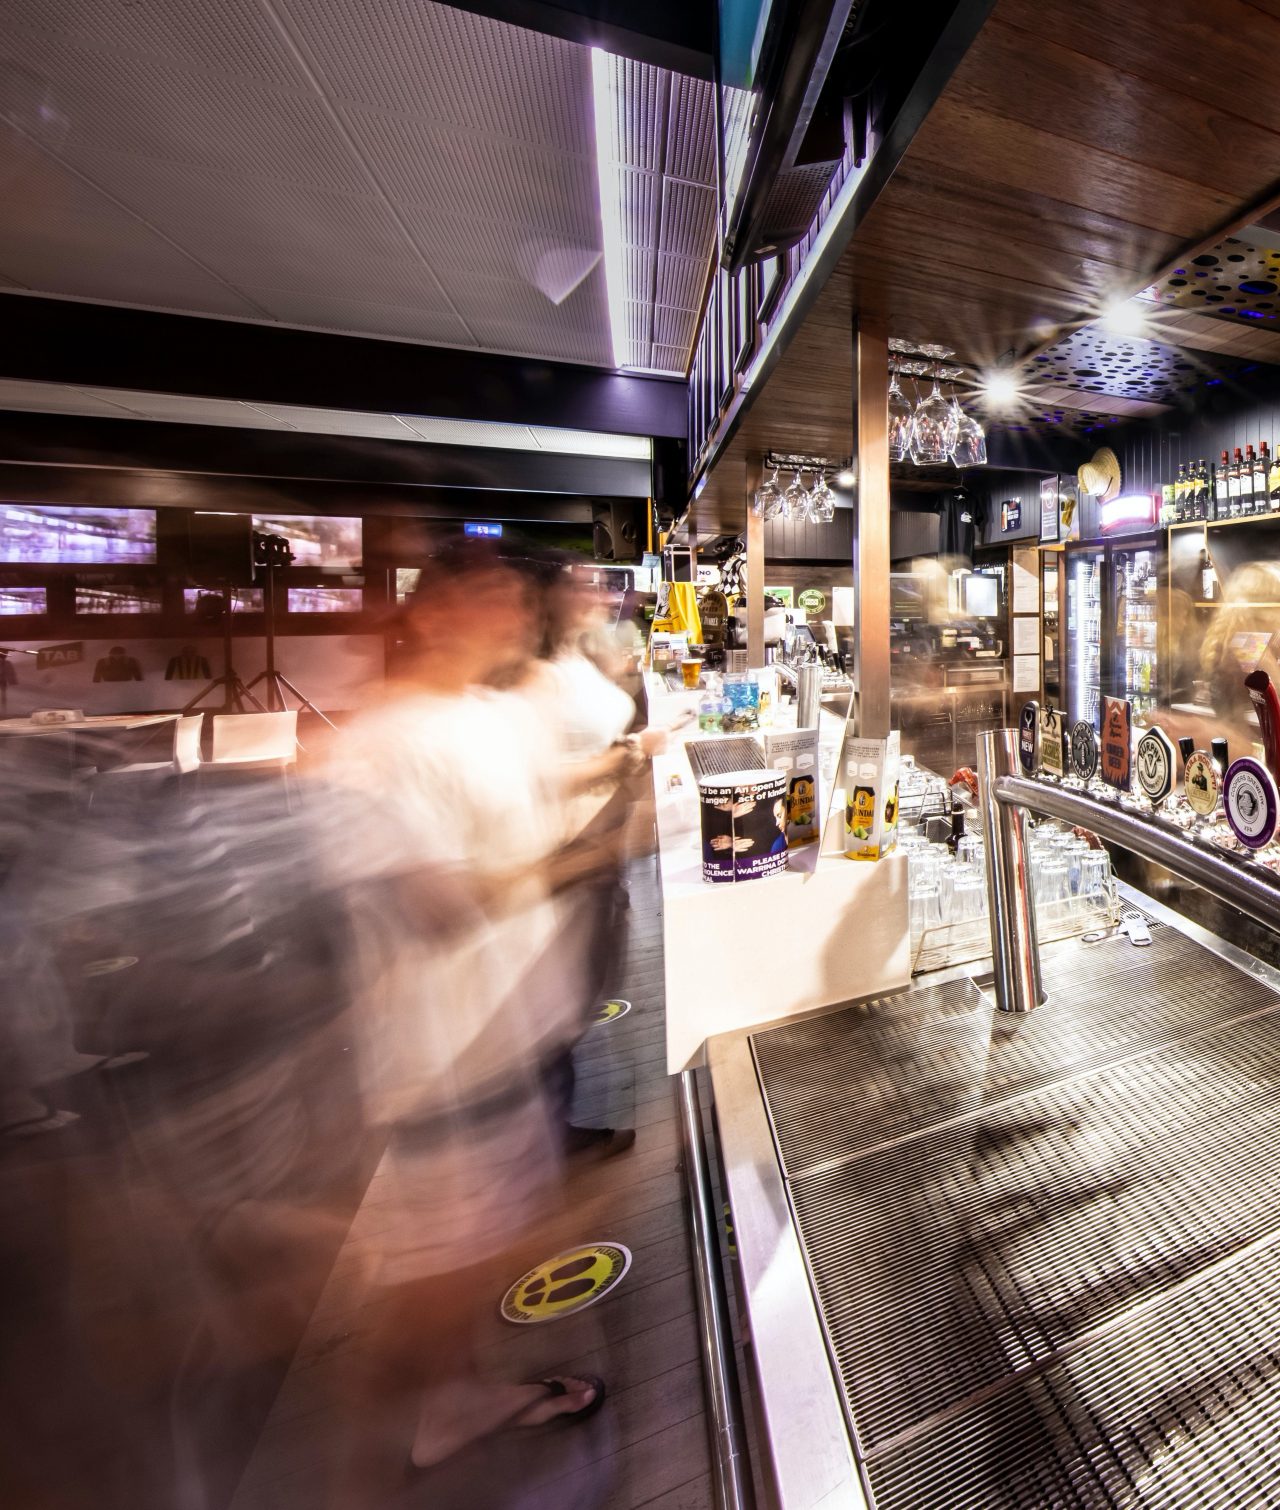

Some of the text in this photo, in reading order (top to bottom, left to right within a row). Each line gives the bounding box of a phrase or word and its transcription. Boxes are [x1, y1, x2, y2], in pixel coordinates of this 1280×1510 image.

[43, 650, 80, 662] TAB
[1022, 740, 1033, 753] NEW
[734, 786, 749, 794] An
[752, 782, 774, 794] open
[1232, 774, 1246, 798] COOPERS
[706, 797, 728, 805] anger
[756, 792, 766, 800] of
[752, 852, 780, 866] PLEASE
[736, 862, 777, 875] WARRINA
